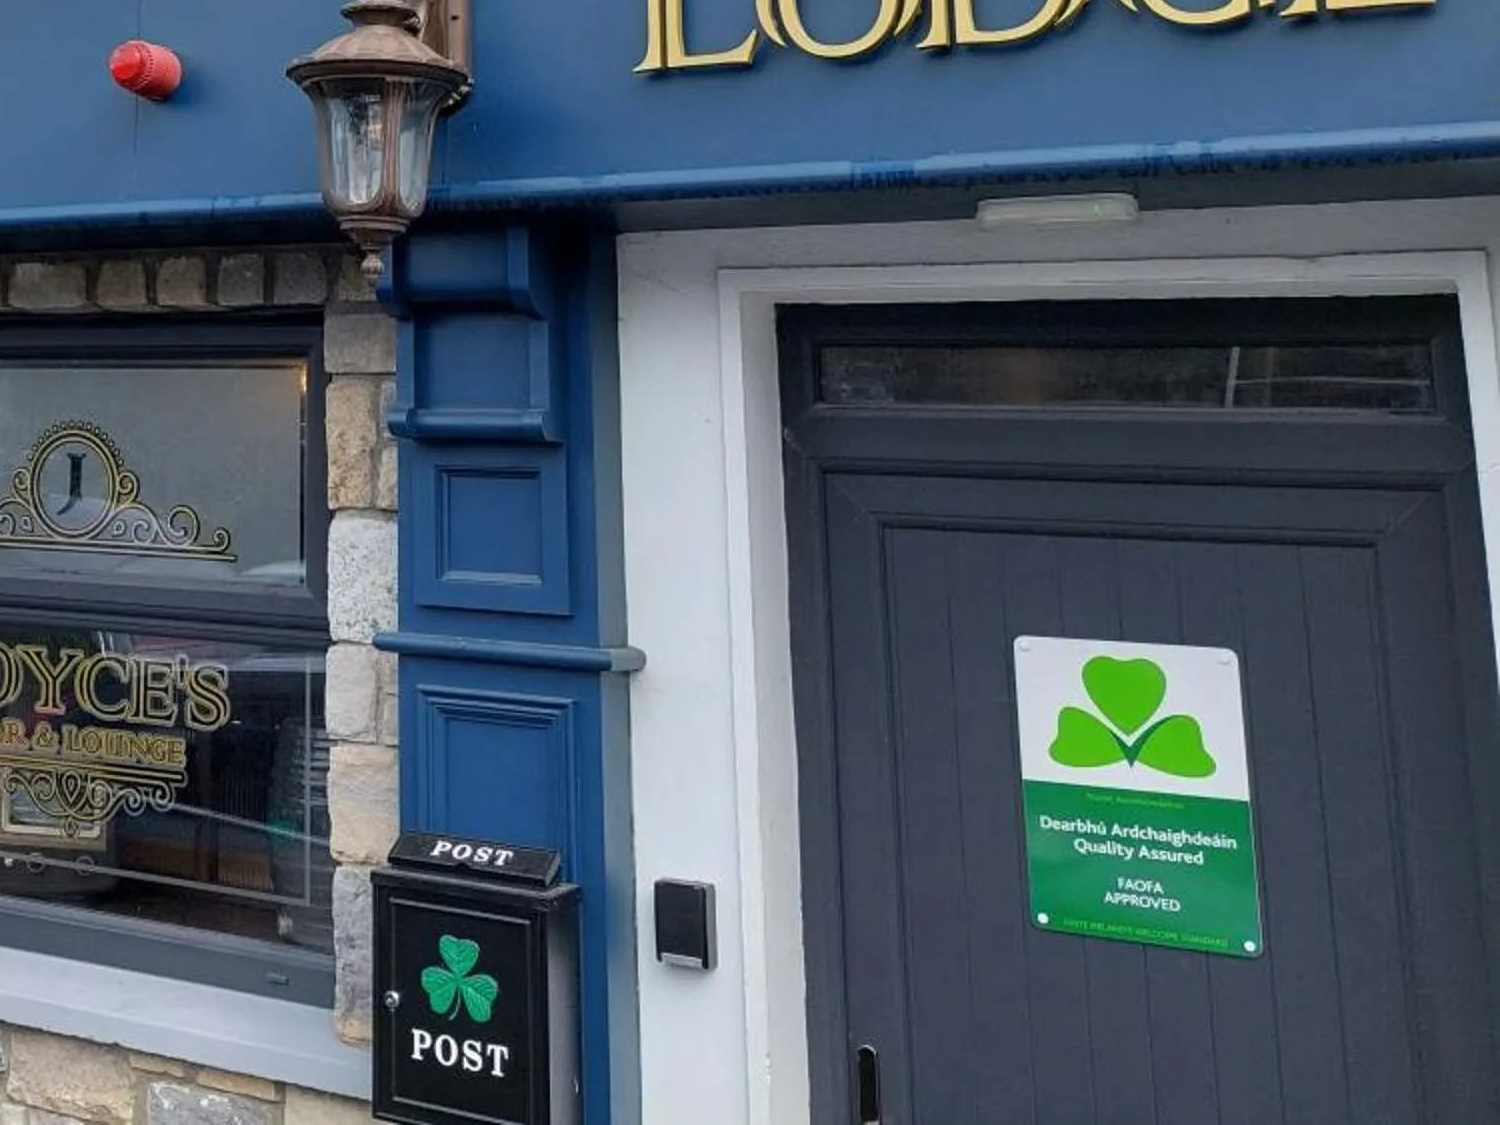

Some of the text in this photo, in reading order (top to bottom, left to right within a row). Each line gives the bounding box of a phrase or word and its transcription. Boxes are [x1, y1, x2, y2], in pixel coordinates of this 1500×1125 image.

[56, 452, 88, 517] J
[31, 724, 57, 750] &
[62, 725, 188, 767] LOUNGE
[1039, 814, 1238, 850] Dearbhú Ardchaighdeáin
[429, 839, 515, 866] POST
[1073, 838, 1205, 866] Quality Assured
[1103, 889, 1181, 913] APPROVED
[410, 1027, 509, 1078] POST
